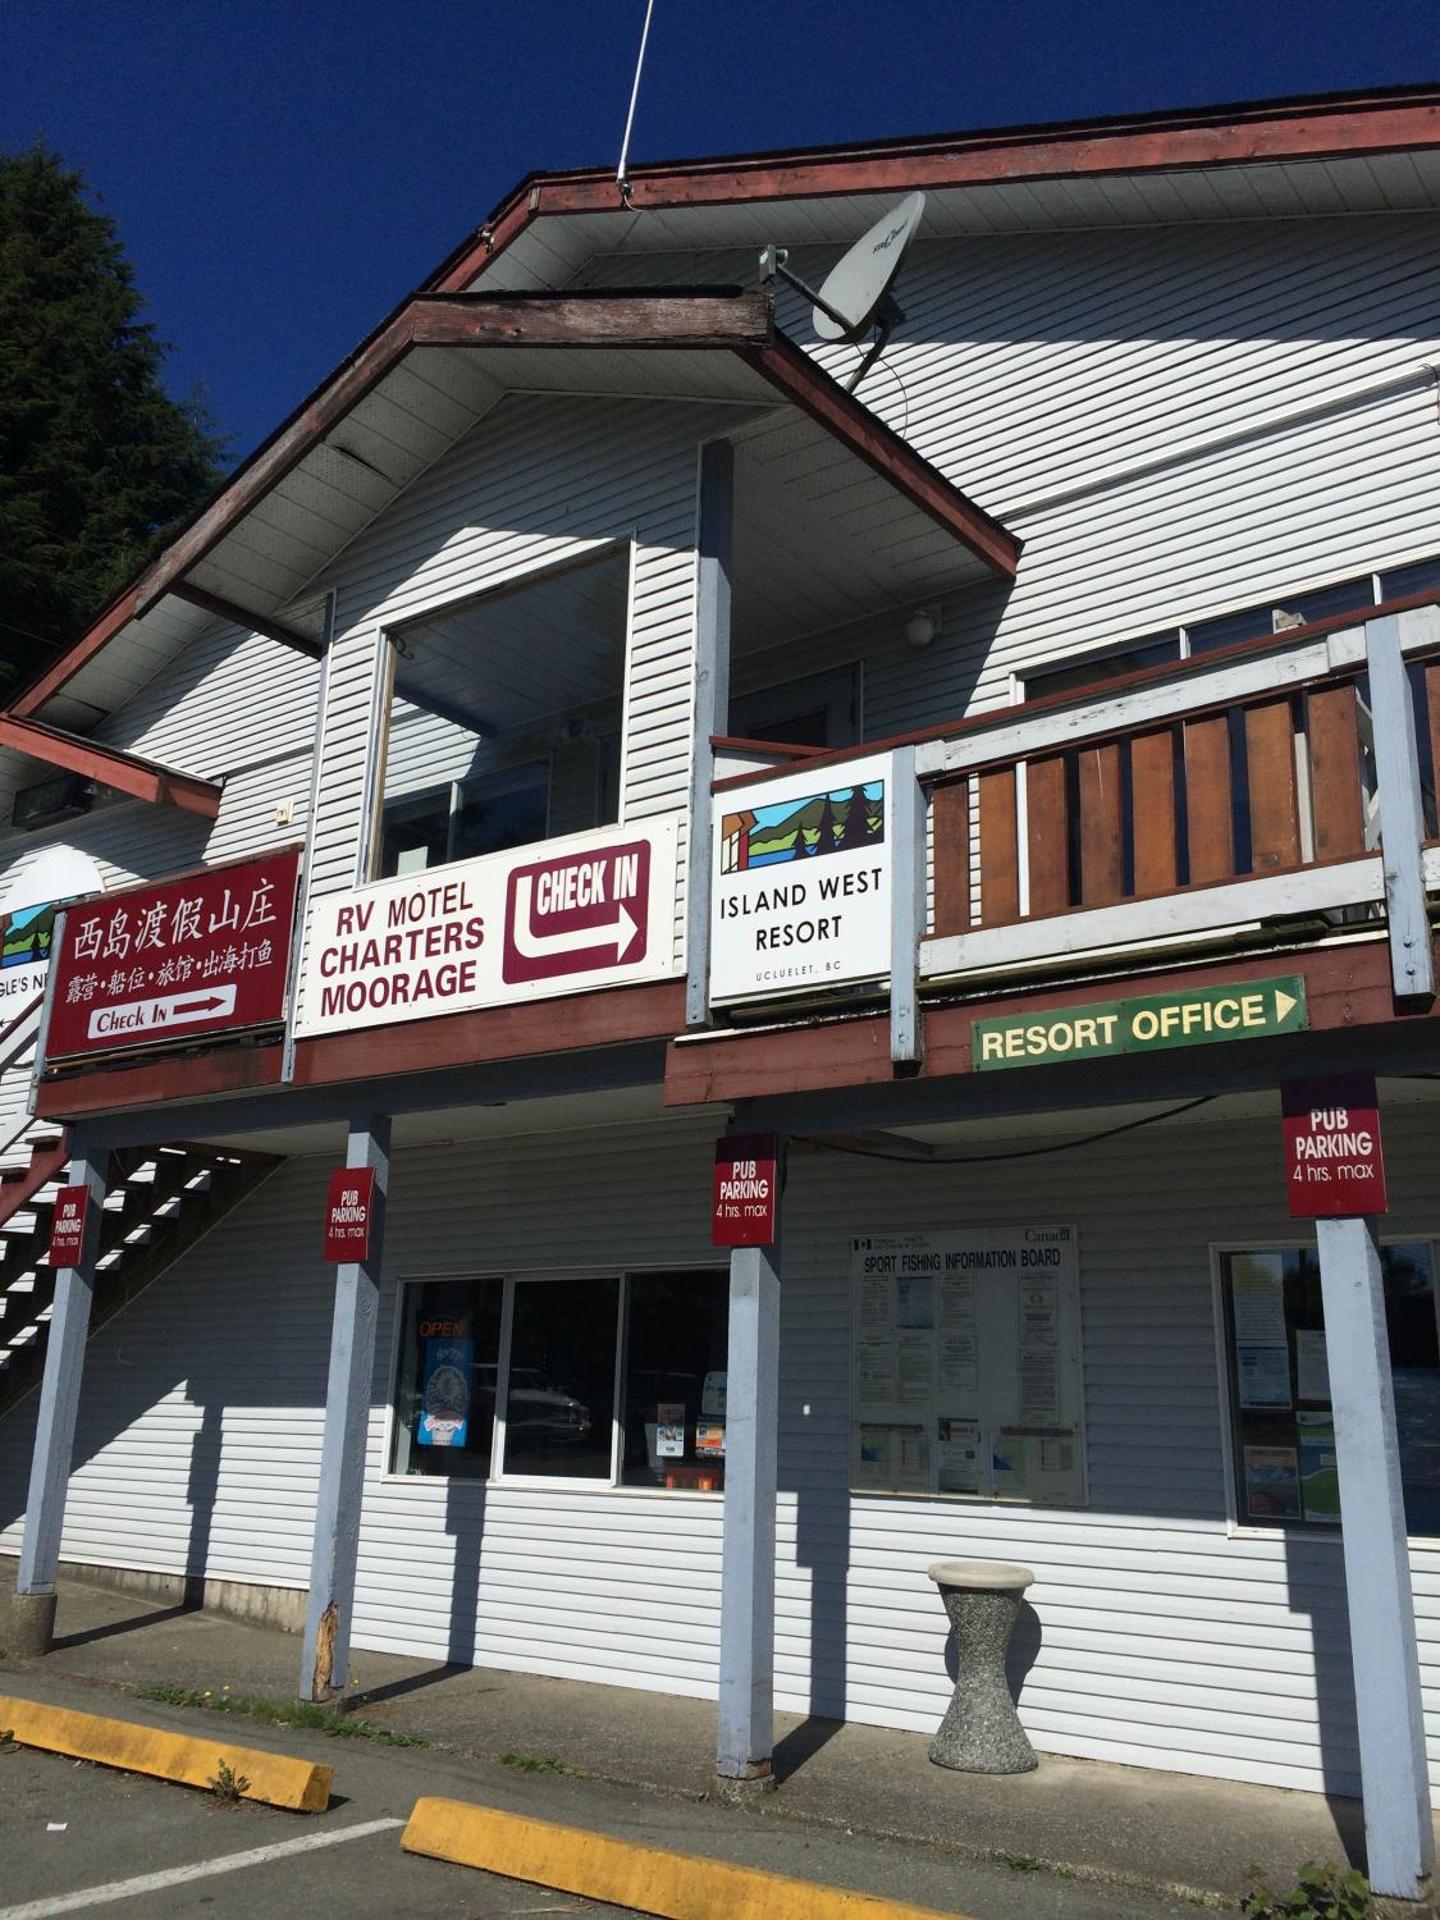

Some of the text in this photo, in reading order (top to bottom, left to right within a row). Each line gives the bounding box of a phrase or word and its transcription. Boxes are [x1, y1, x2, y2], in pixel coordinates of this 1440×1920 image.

[536, 854, 638, 916] CHECK IN
[721, 868, 882, 919] ISLAND WEST
[74, 878, 277, 961] 西岛渡假山庄
[336, 880, 473, 937] RV MOTEL
[756, 915, 842, 951] RESORT
[320, 917, 485, 977] CHARTERS
[825, 961, 841, 971] BC
[321, 960, 477, 1017] MOORAGE
[982, 994, 1266, 1061] RESORT OFFICE
[1310, 1107, 1349, 1131] PUB
[1295, 1132, 1373, 1160] PARKING
[732, 1161, 756, 1179] PUB
[1293, 1164, 1374, 1182] 4 hrs. max
[341, 1190, 359, 1206] PUB
[720, 1179, 769, 1200] PARKING
[62, 1203, 77, 1218] PUB
[331, 1207, 366, 1223] PARKING
[716, 1204, 768, 1218] 4 hrs. max
[55, 1219, 81, 1233] PARKING
[329, 1227, 333, 1237] 4
[348, 1227, 364, 1238] max
[864, 1248, 1061, 1273] SPORT FISHING INFORMATION BOARD
[419, 1320, 465, 1338] OPEN
